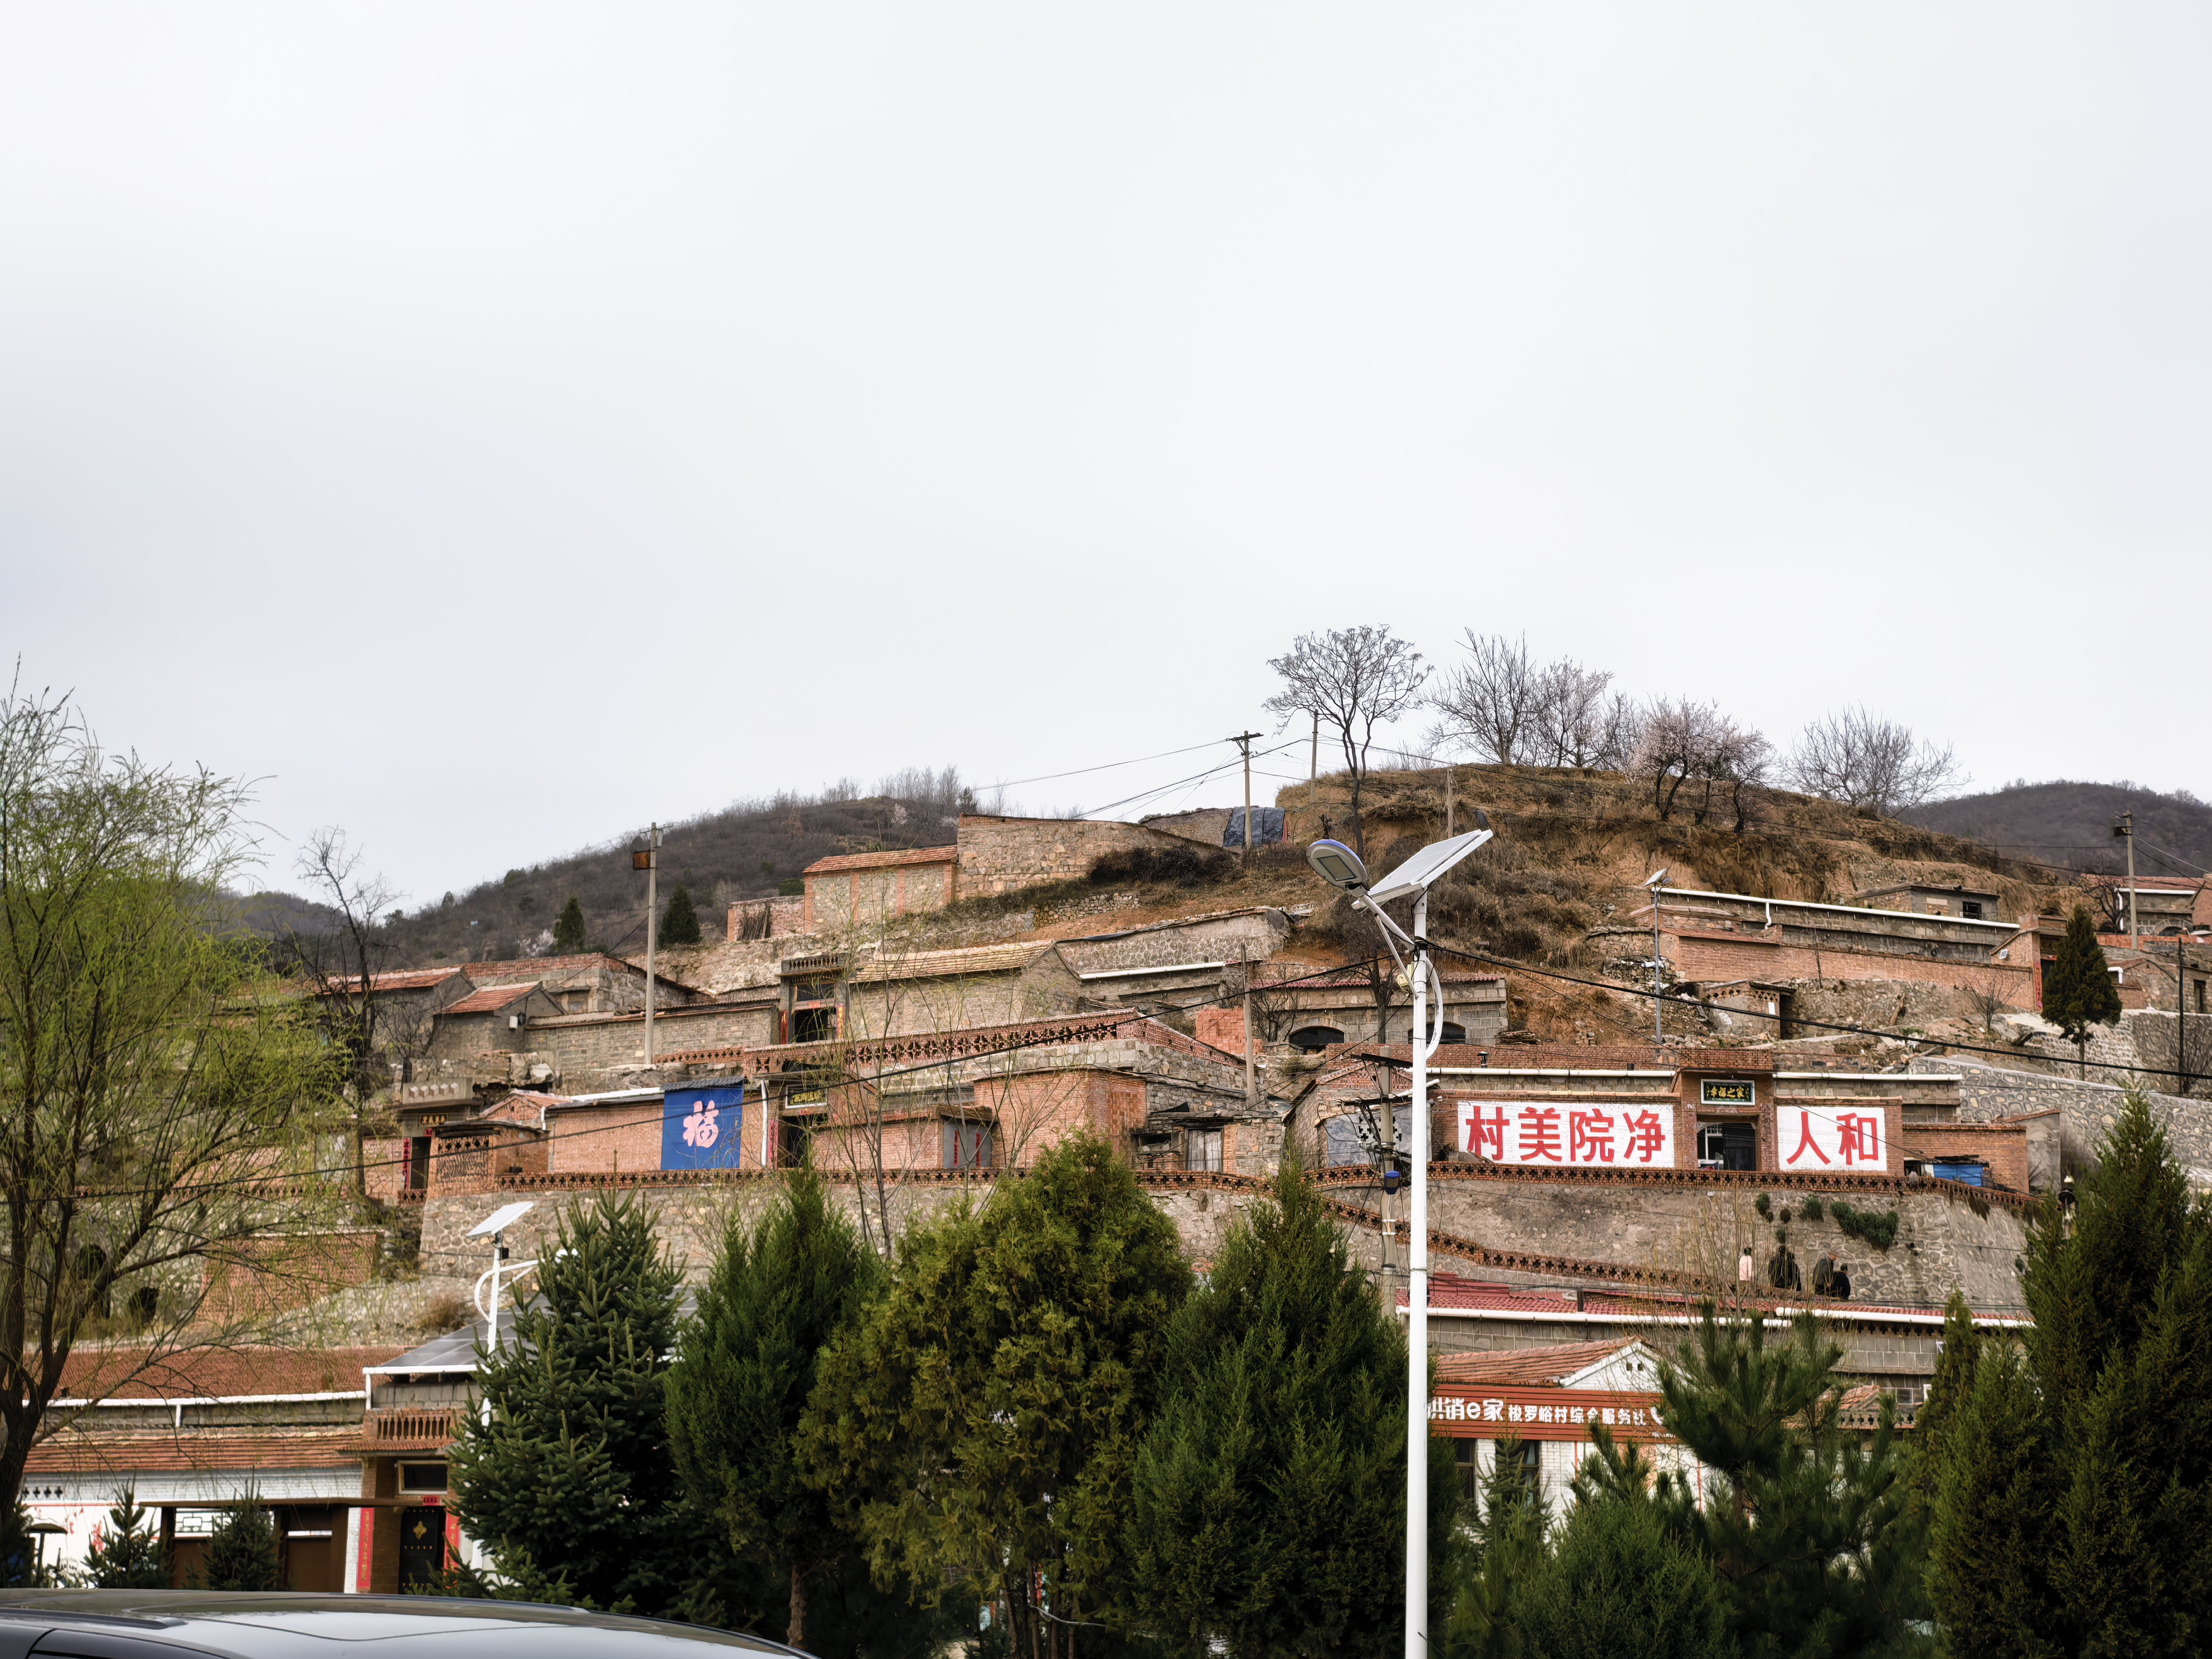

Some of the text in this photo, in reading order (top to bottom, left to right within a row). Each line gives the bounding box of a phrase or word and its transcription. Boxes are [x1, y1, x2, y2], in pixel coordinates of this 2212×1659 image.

[683, 1100, 720, 1148] 福
[1465, 1105, 1666, 1163] 村美院净
[1786, 1111, 1879, 1165] 人和
